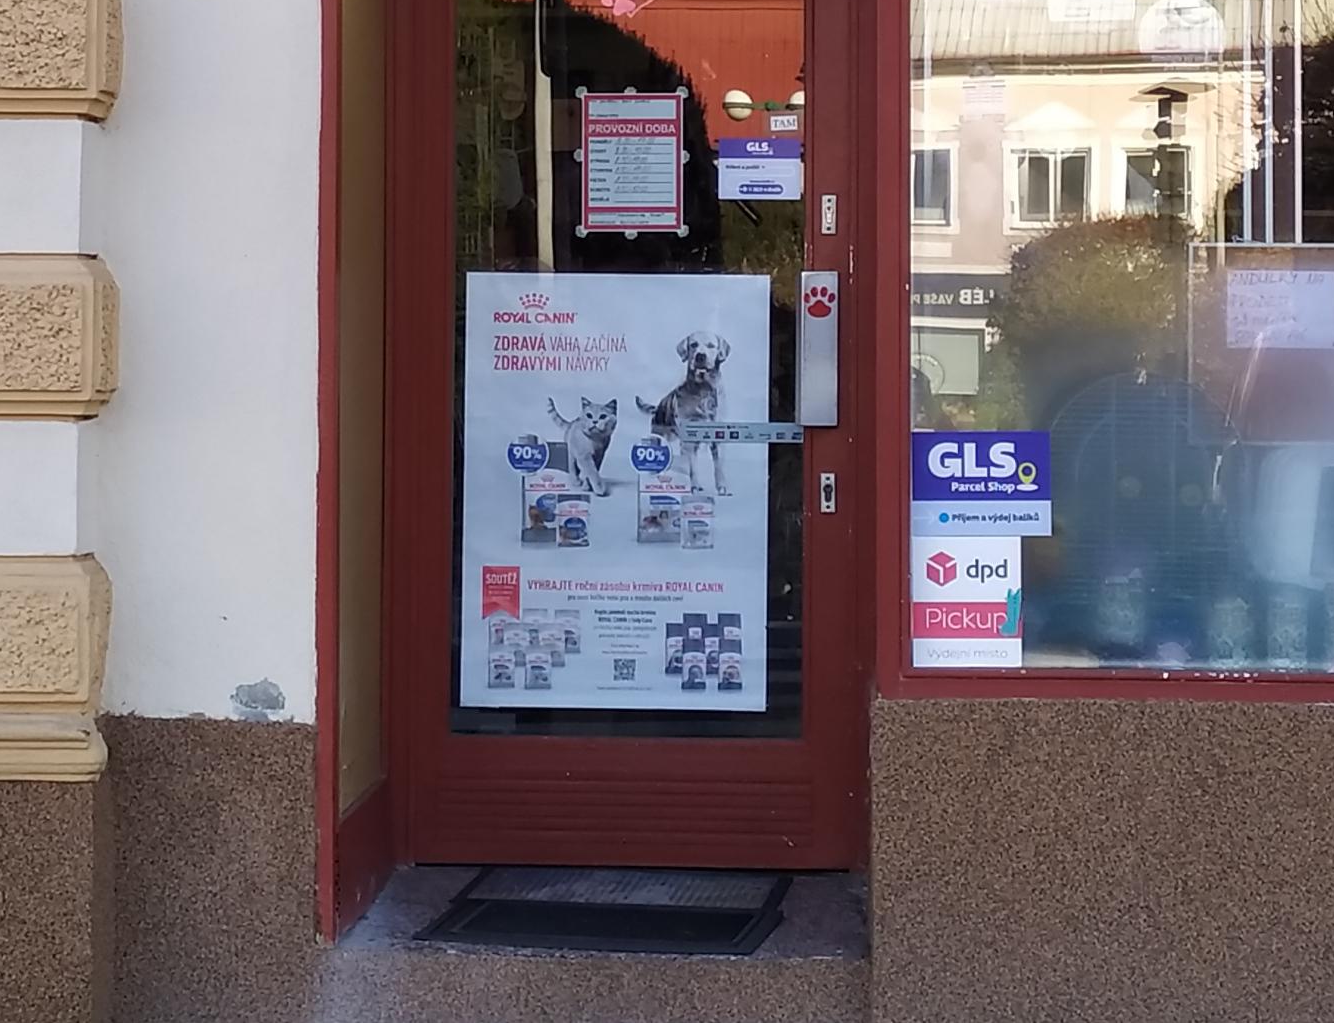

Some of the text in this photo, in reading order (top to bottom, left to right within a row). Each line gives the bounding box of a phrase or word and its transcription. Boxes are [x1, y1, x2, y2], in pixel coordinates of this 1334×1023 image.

[588, 122, 676, 134] PROVOZNÍ DOBA
[746, 142, 769, 152] GLS
[493, 312, 576, 324] ROYAL CANIN
[493, 332, 547, 352] ZDRAVÁ
[584, 333, 628, 353] ZAČÍNÁ
[493, 351, 610, 372] ZDRAVÝMI NÁVYKY
[513, 446, 542, 460] 90%
[636, 448, 665, 462] 90%
[927, 441, 1017, 479] GLS
[951, 481, 1016, 494] Parcel Shop
[966, 559, 1008, 584] dpd
[527, 579, 572, 591] VYHRAJTE
[665, 581, 693, 593] ROYAL
[925, 608, 1008, 634] Pickup
